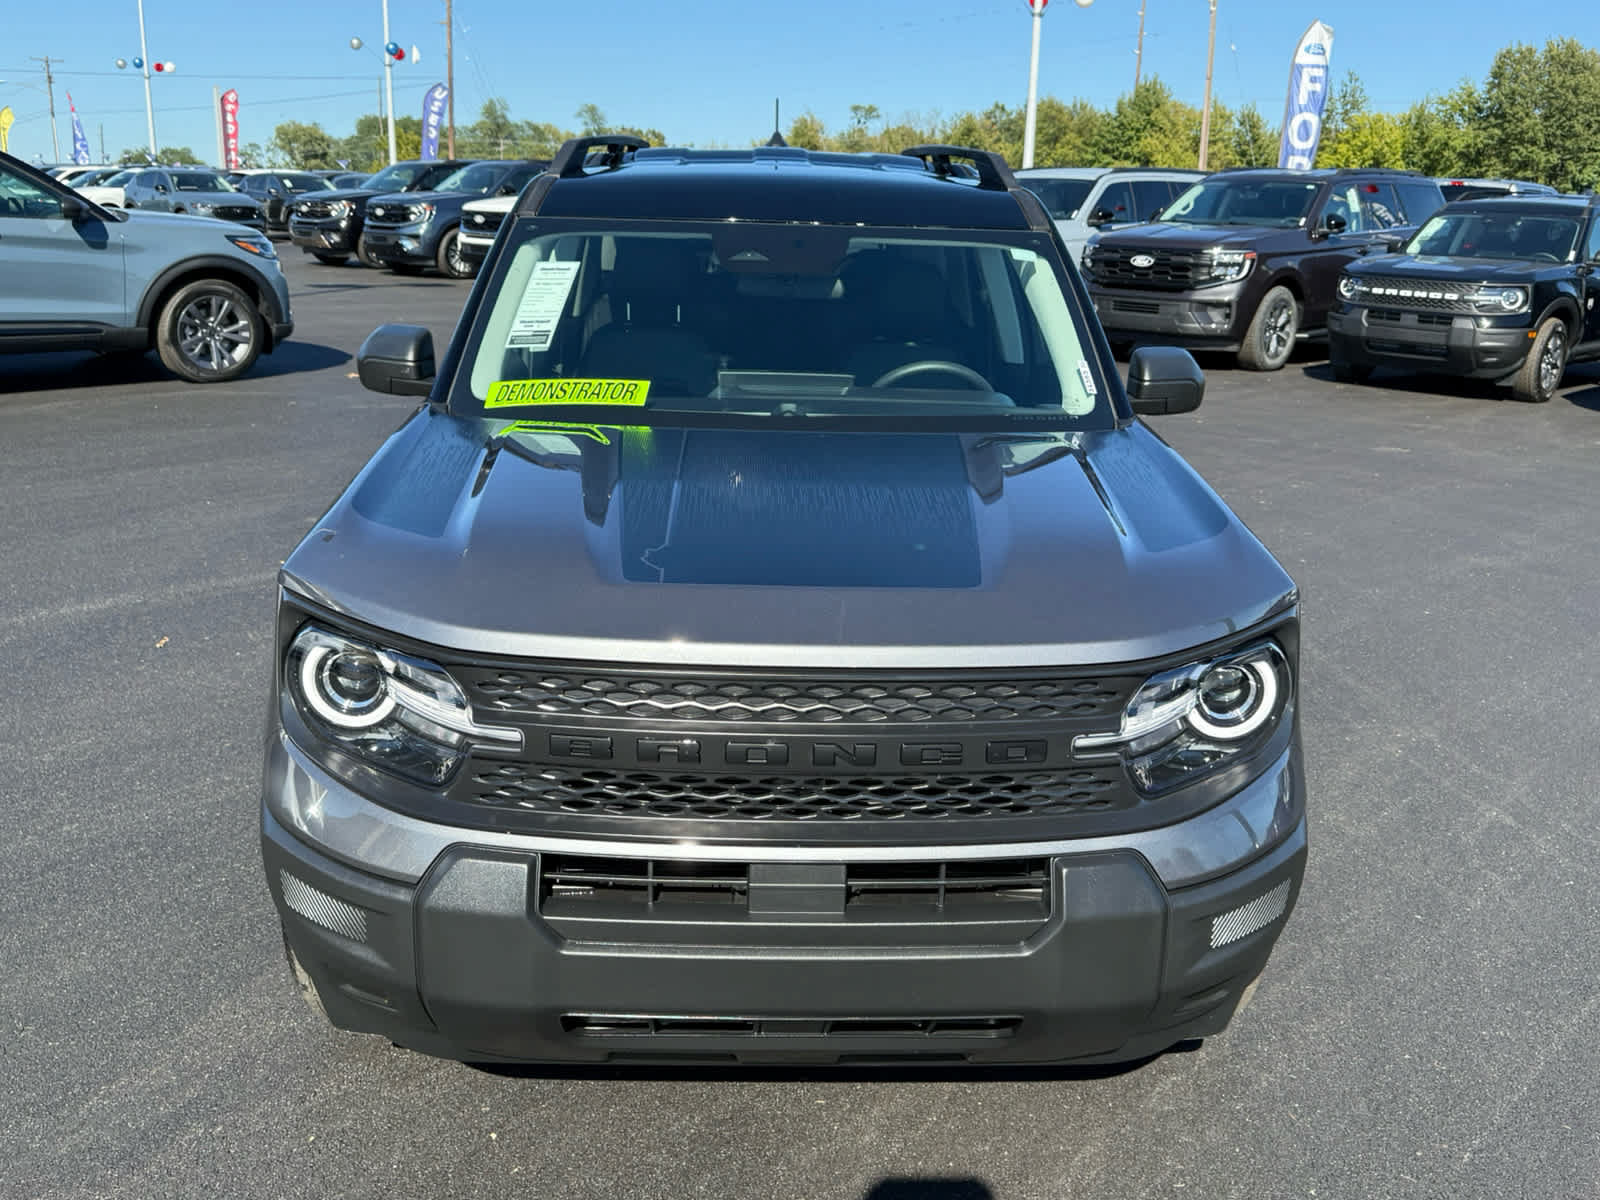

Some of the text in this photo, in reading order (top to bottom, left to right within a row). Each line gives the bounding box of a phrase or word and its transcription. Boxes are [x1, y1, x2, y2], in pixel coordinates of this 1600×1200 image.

[1371, 287, 1459, 300] BRONCO
[495, 381, 639, 403] DEMONSTRATOR
[550, 733, 1048, 766] BRONCO
